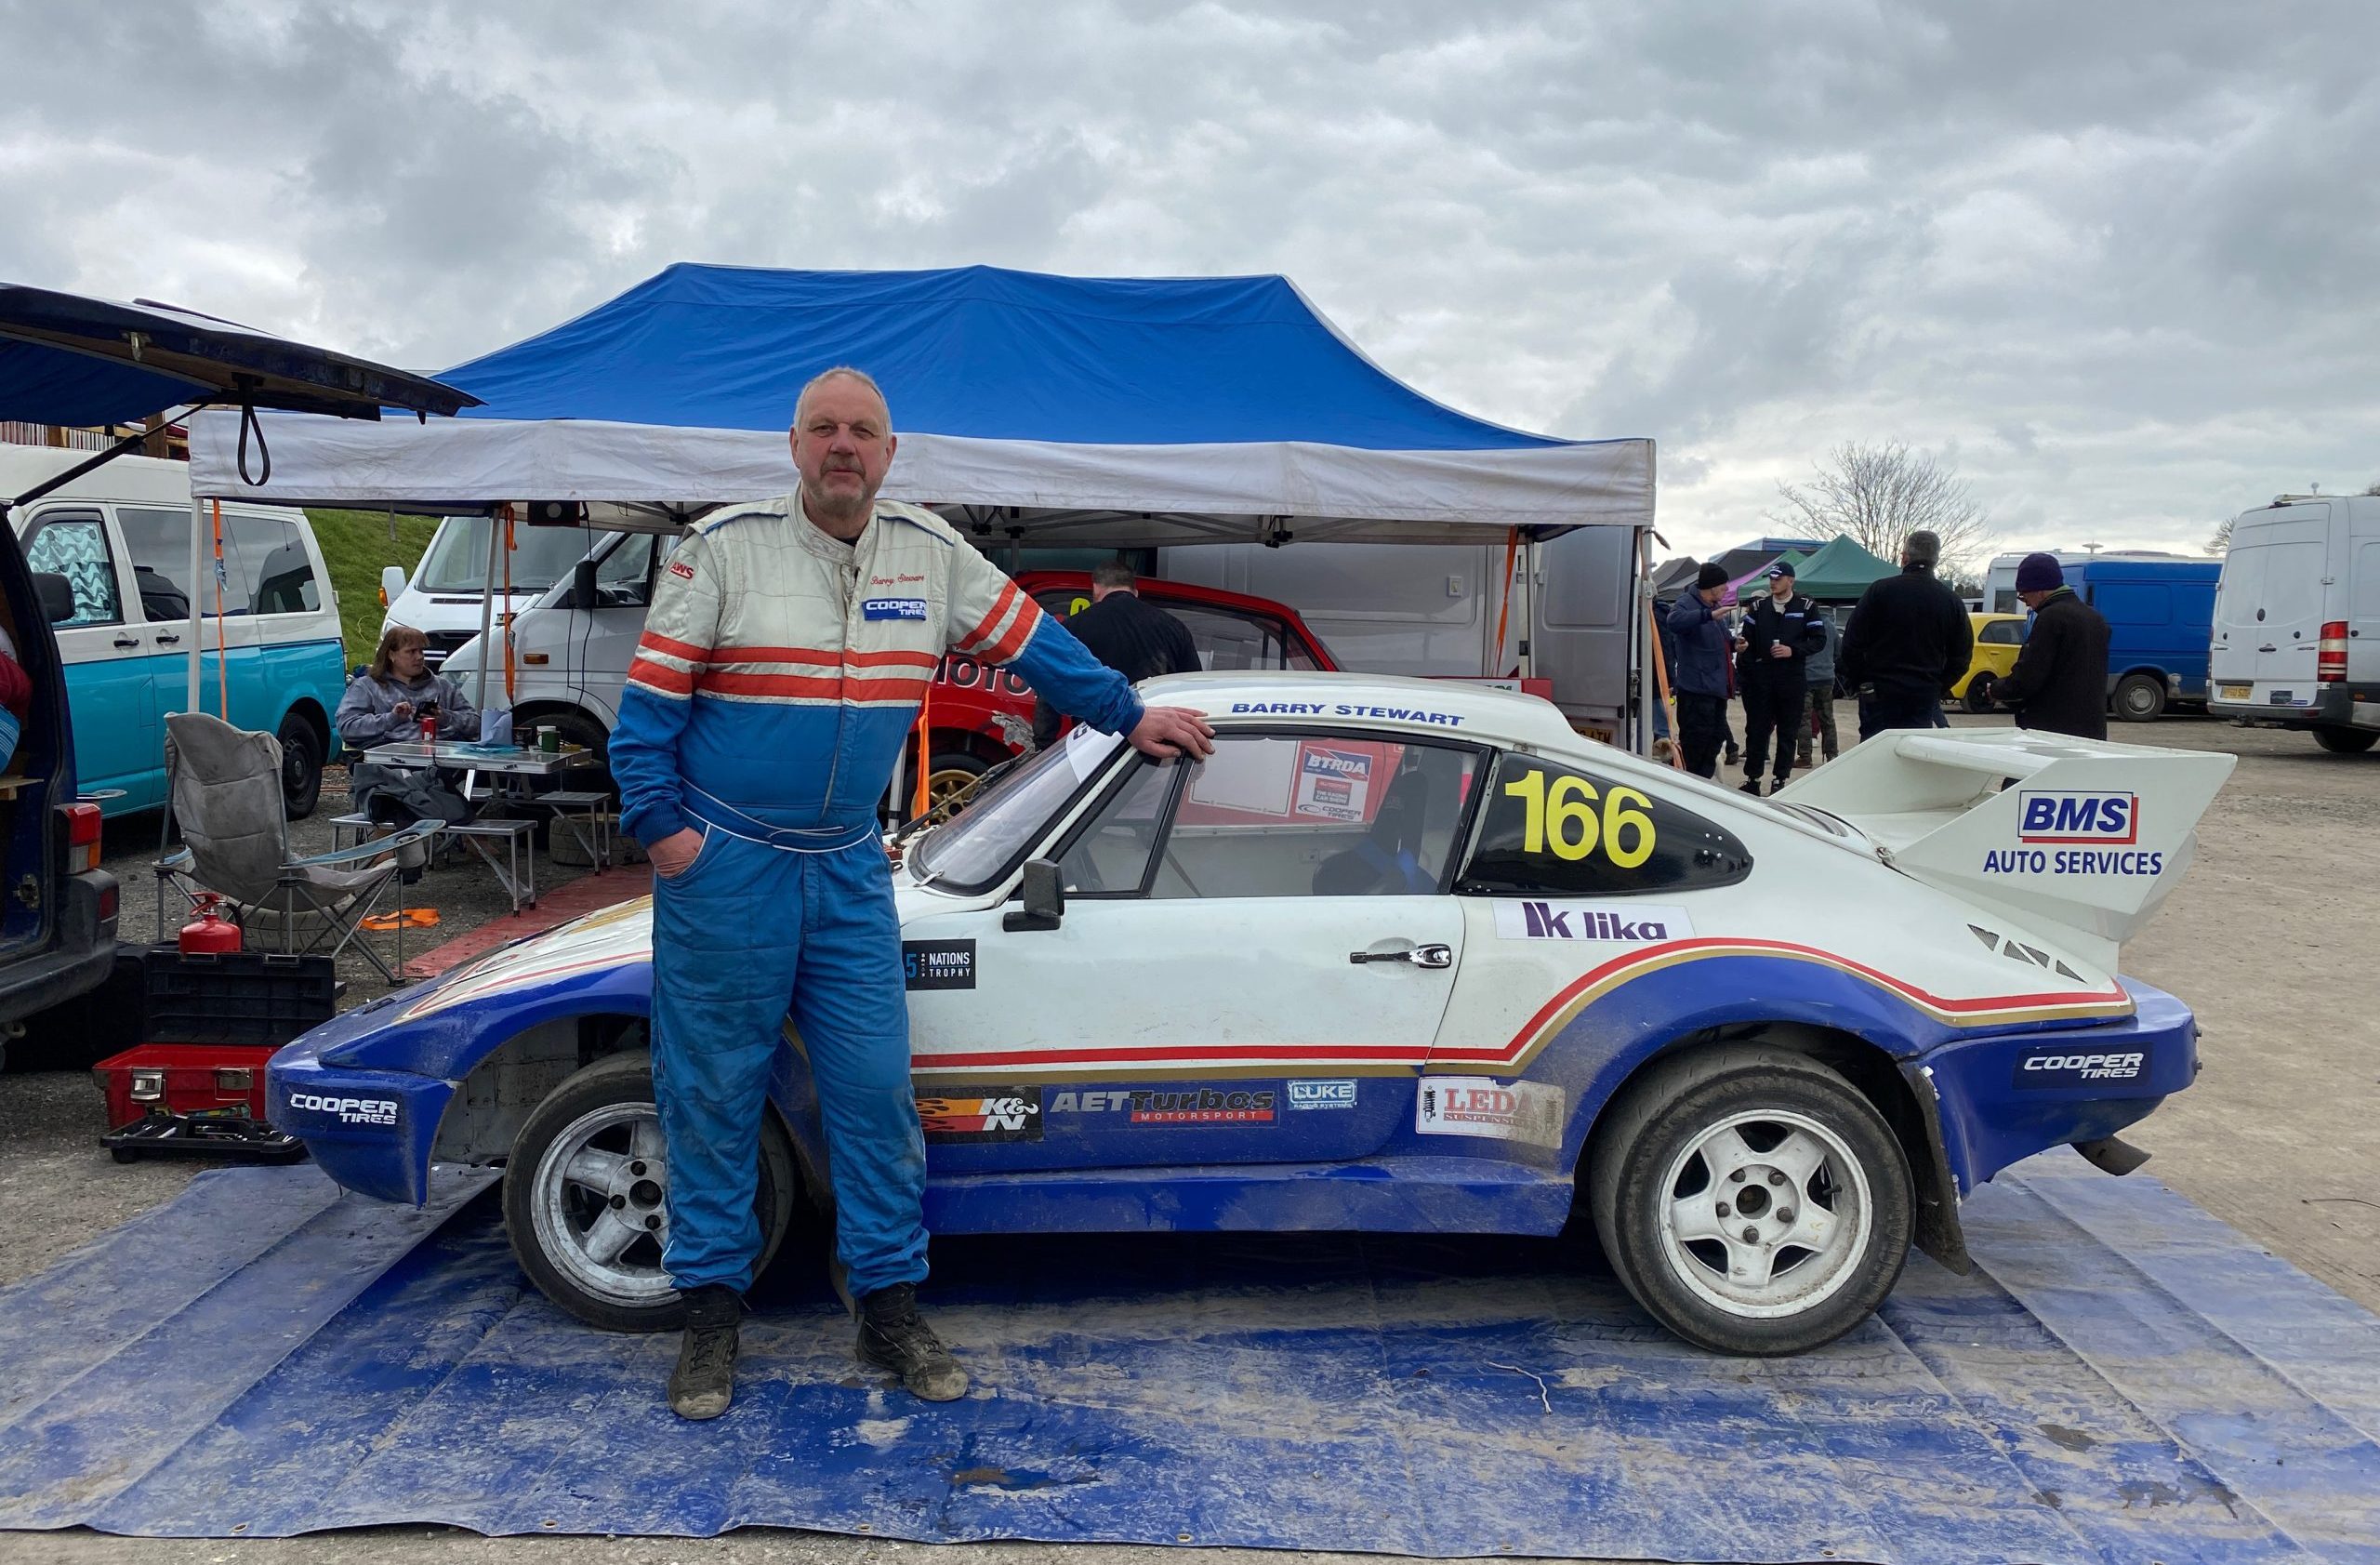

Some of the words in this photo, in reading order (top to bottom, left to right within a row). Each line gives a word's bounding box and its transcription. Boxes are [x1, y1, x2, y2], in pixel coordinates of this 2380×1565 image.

[866, 601, 926, 610] COOPER
[1232, 703, 1327, 713] BARRY
[1334, 705, 1465, 726] STEWART
[1307, 754, 1366, 775] BTRDA
[1322, 805, 1361, 816] COOPER
[1505, 770, 1656, 869] 166
[2022, 798, 2129, 832] BMS
[1983, 850, 2046, 874] AUTO
[2054, 851, 2162, 875] SERVICES
[1583, 911, 1668, 940] lika
[906, 953, 918, 978] 5
[930, 952, 970, 965] NATIONS
[930, 968, 971, 977] TROPHY
[2024, 1053, 2144, 1070] COOPER
[2081, 1068, 2139, 1079] TIRES
[1293, 1085, 1353, 1098] LUKE
[290, 1094, 398, 1115] COOPER
[1444, 1088, 1535, 1119] LEDA
[339, 1113, 397, 1125] TIRES
[1141, 1111, 1257, 1121] MOTORSPORT
